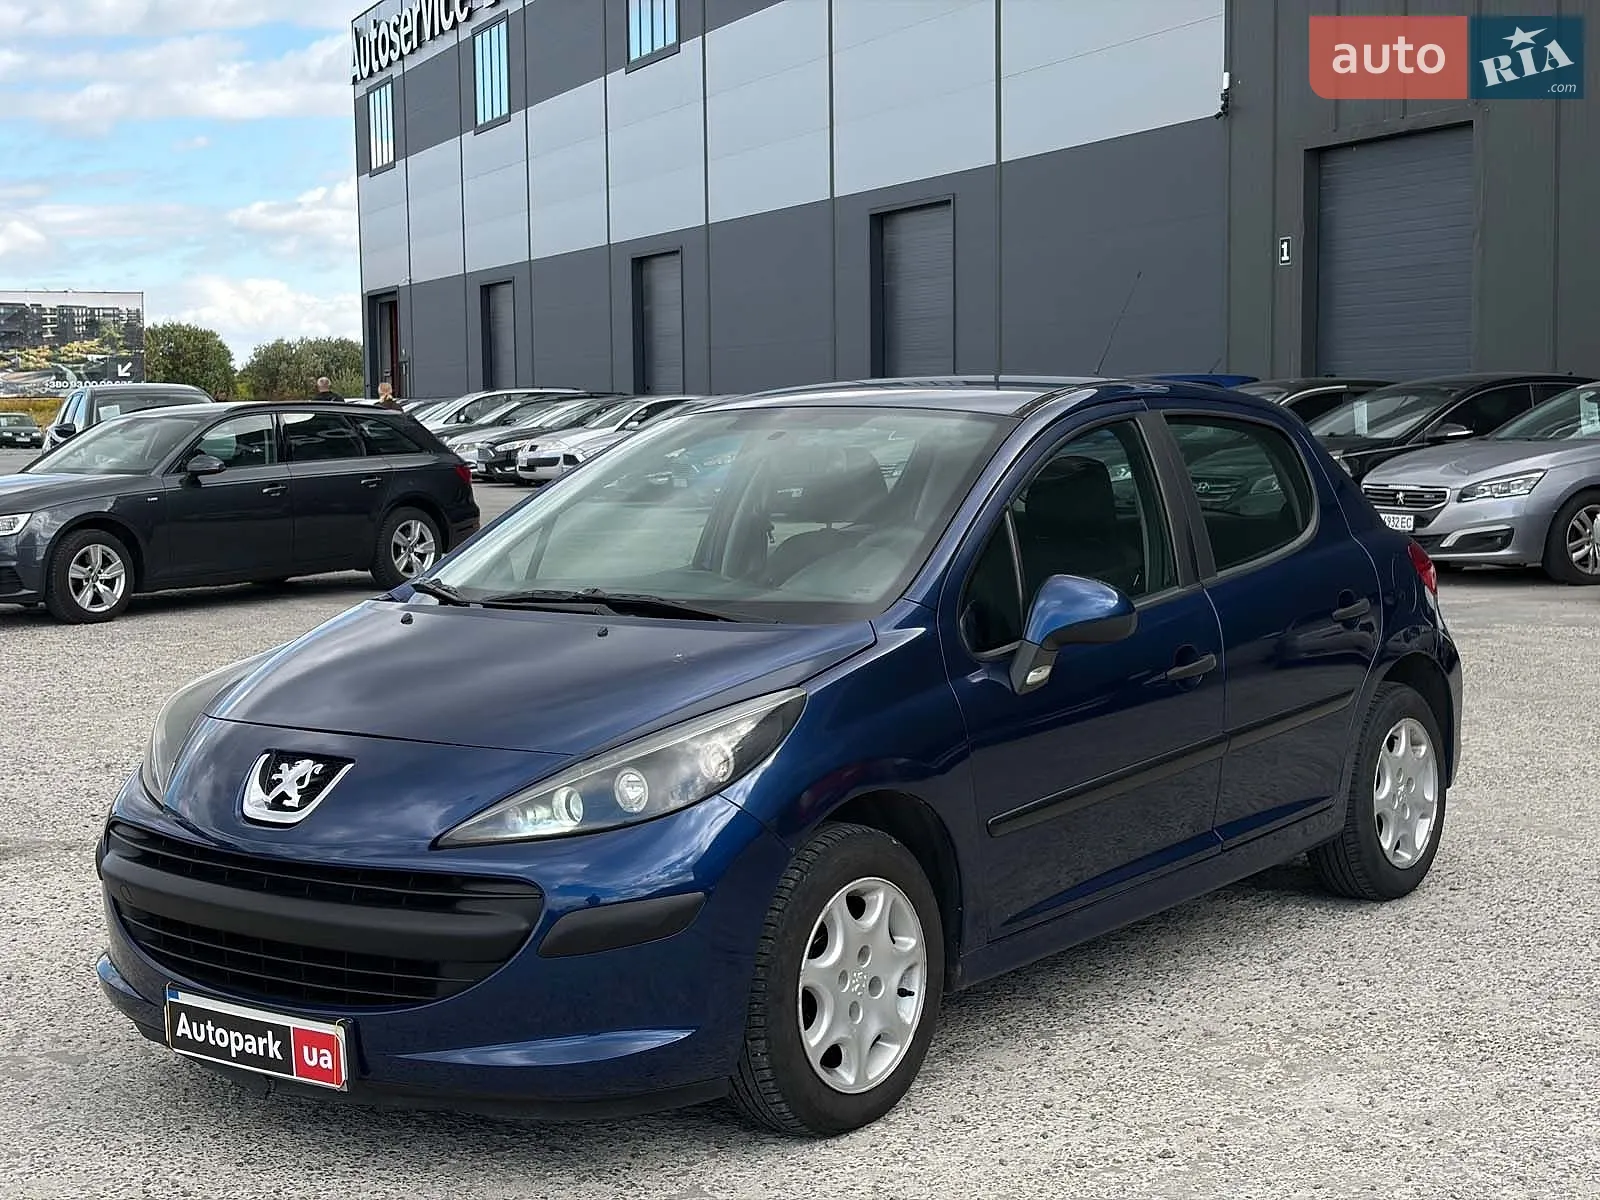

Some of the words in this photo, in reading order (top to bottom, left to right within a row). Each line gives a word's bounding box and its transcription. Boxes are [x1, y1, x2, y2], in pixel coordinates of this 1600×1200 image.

[1281, 241, 1289, 260] 1
[175, 1012, 283, 1060] Autopark
[302, 1044, 333, 1070] ua
